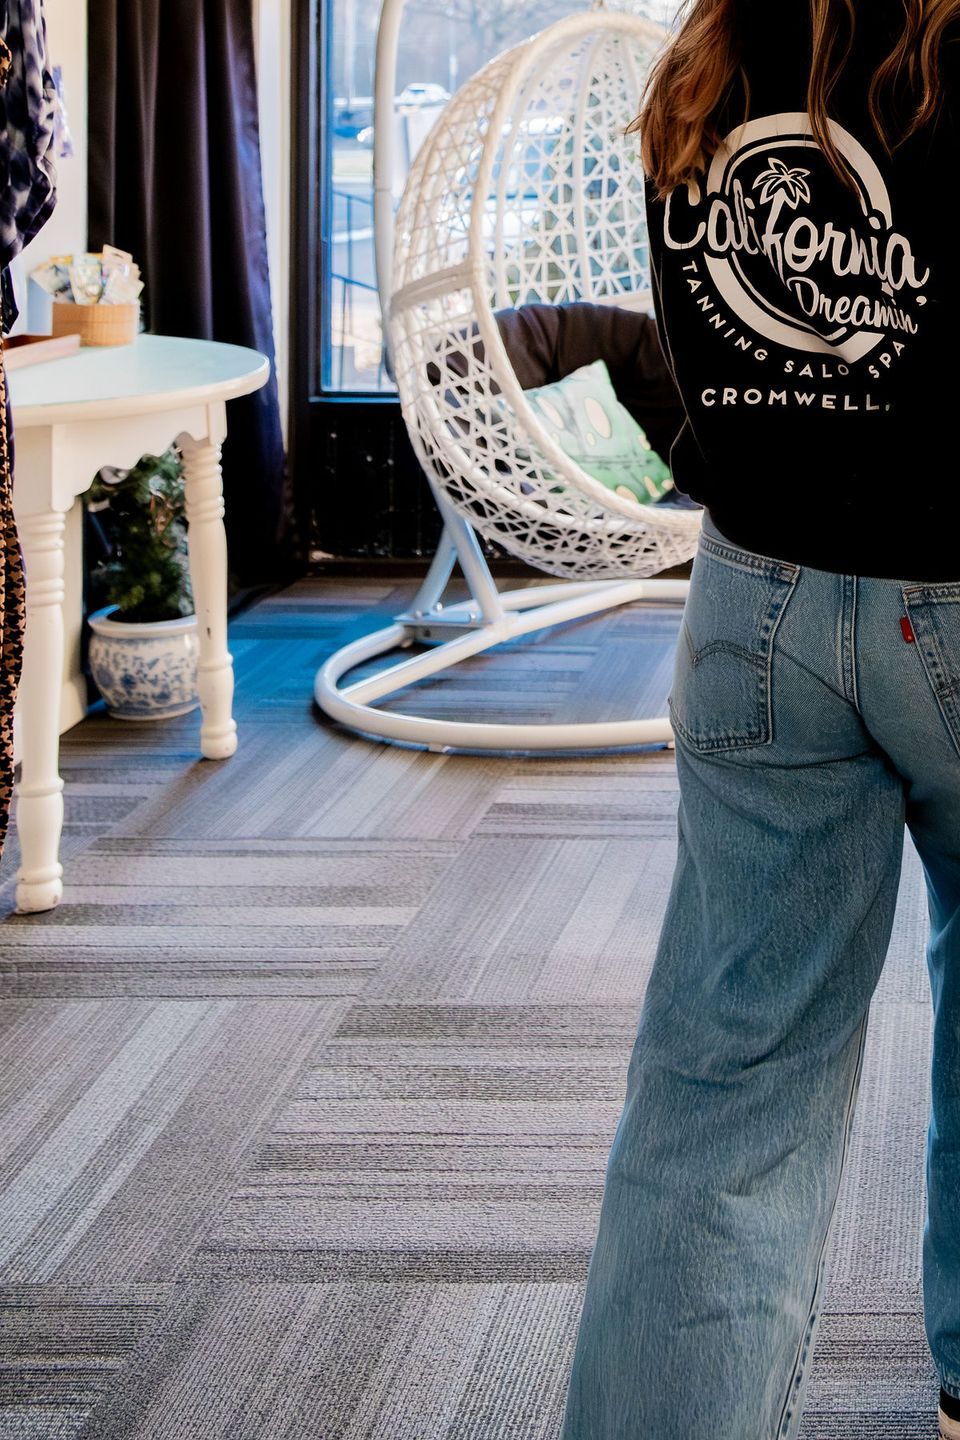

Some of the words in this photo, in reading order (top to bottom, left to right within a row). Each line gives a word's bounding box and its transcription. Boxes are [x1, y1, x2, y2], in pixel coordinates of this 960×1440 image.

[663, 177, 930, 291] California
[682, 260, 768, 361] TANNING
[784, 359, 850, 378] SALO
[868, 341, 905, 379] SPA
